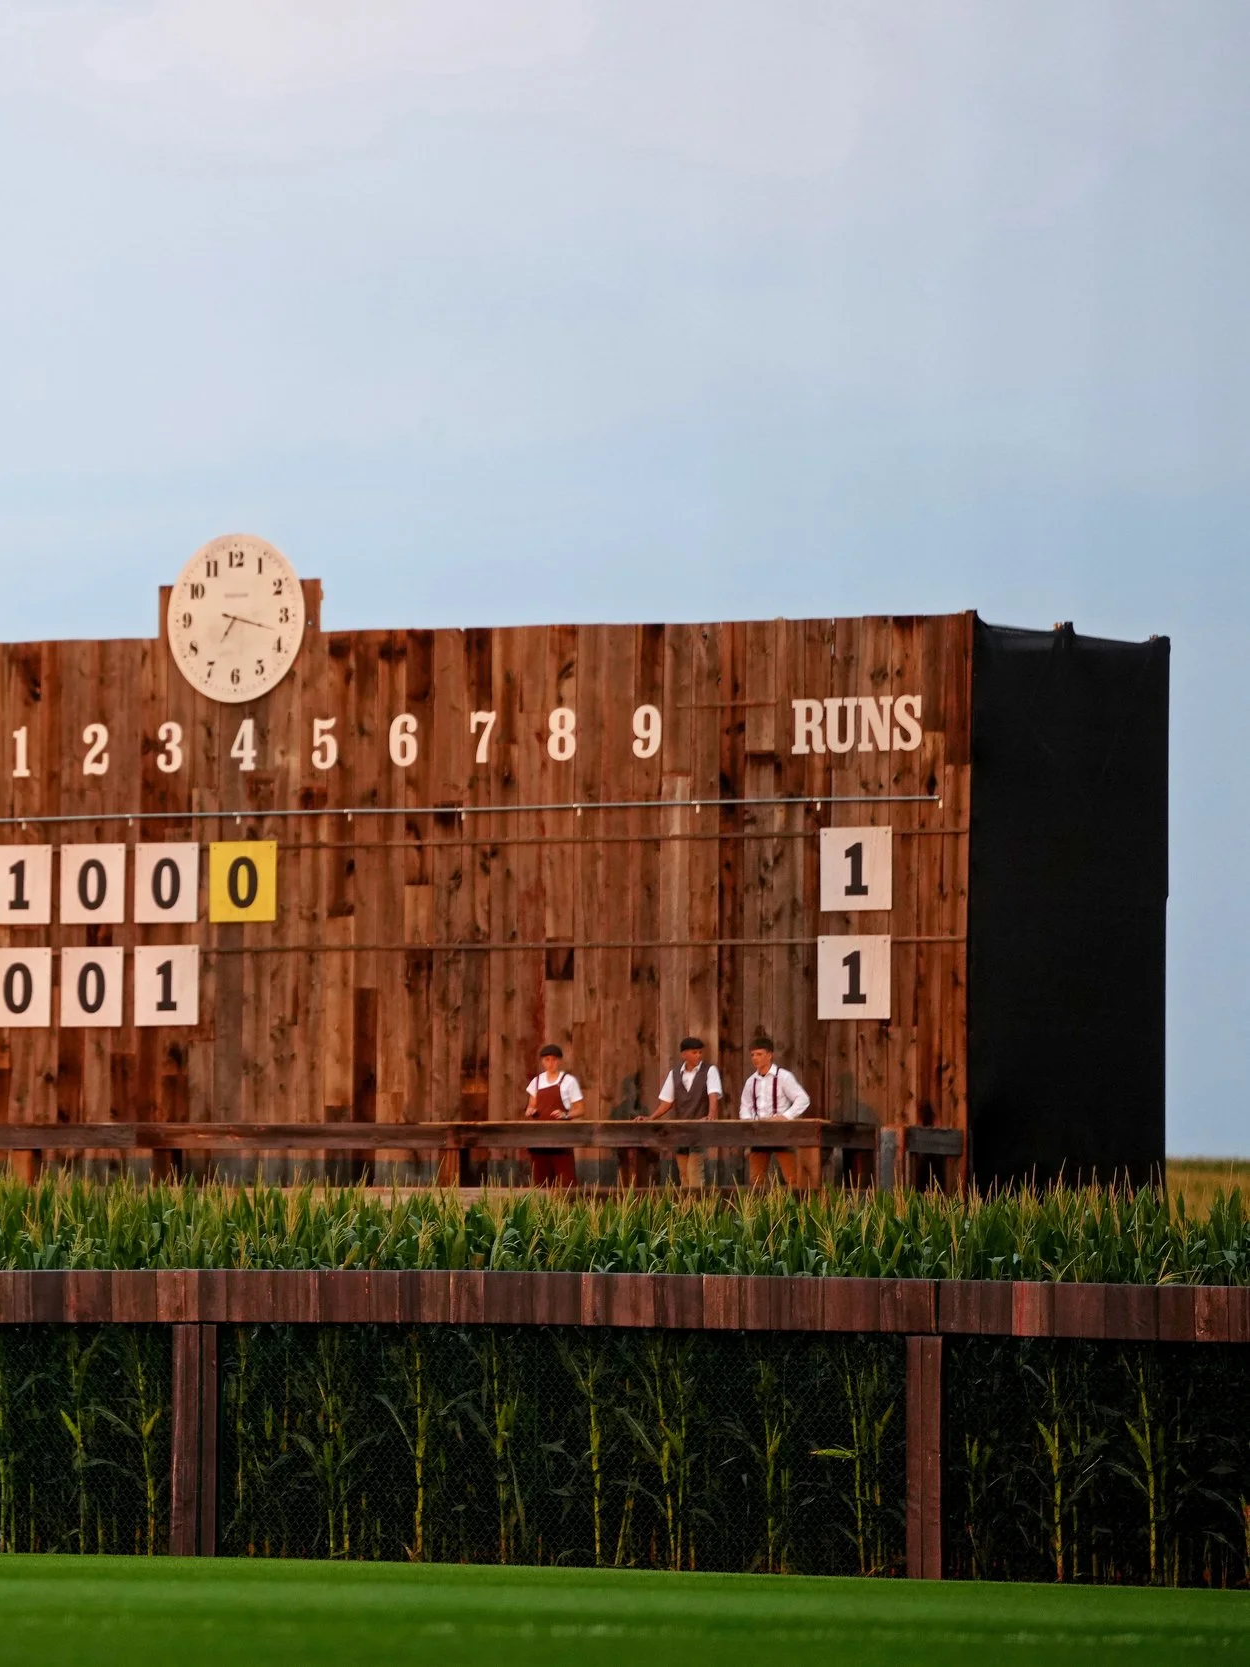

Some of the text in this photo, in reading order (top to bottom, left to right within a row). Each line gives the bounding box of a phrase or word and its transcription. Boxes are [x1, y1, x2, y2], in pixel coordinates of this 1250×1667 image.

[228, 551, 244, 568] 12
[257, 557, 263, 575] 1
[206, 560, 218, 578] 11
[190, 583, 205, 600] 10
[273, 578, 283, 596] 2
[182, 612, 192, 629] 9
[279, 607, 289, 624] 3
[189, 640, 198, 656] 8
[272, 635, 282, 653] 4
[207, 661, 216, 679] 7
[231, 668, 240, 685] 6
[255, 659, 264, 676] 5
[12, 694, 922, 777] 1 2 3 4 5 6 7 8 9 RUNS
[8, 859, 30, 910] 1
[78, 859, 107, 910] 0
[152, 858, 181, 910] 0
[227, 856, 258, 909] 0
[844, 842, 869, 896] 1
[3, 962, 33, 1014] 0
[77, 962, 105, 1014] 0
[156, 960, 177, 1011] 1
[842, 950, 867, 1005] 1
